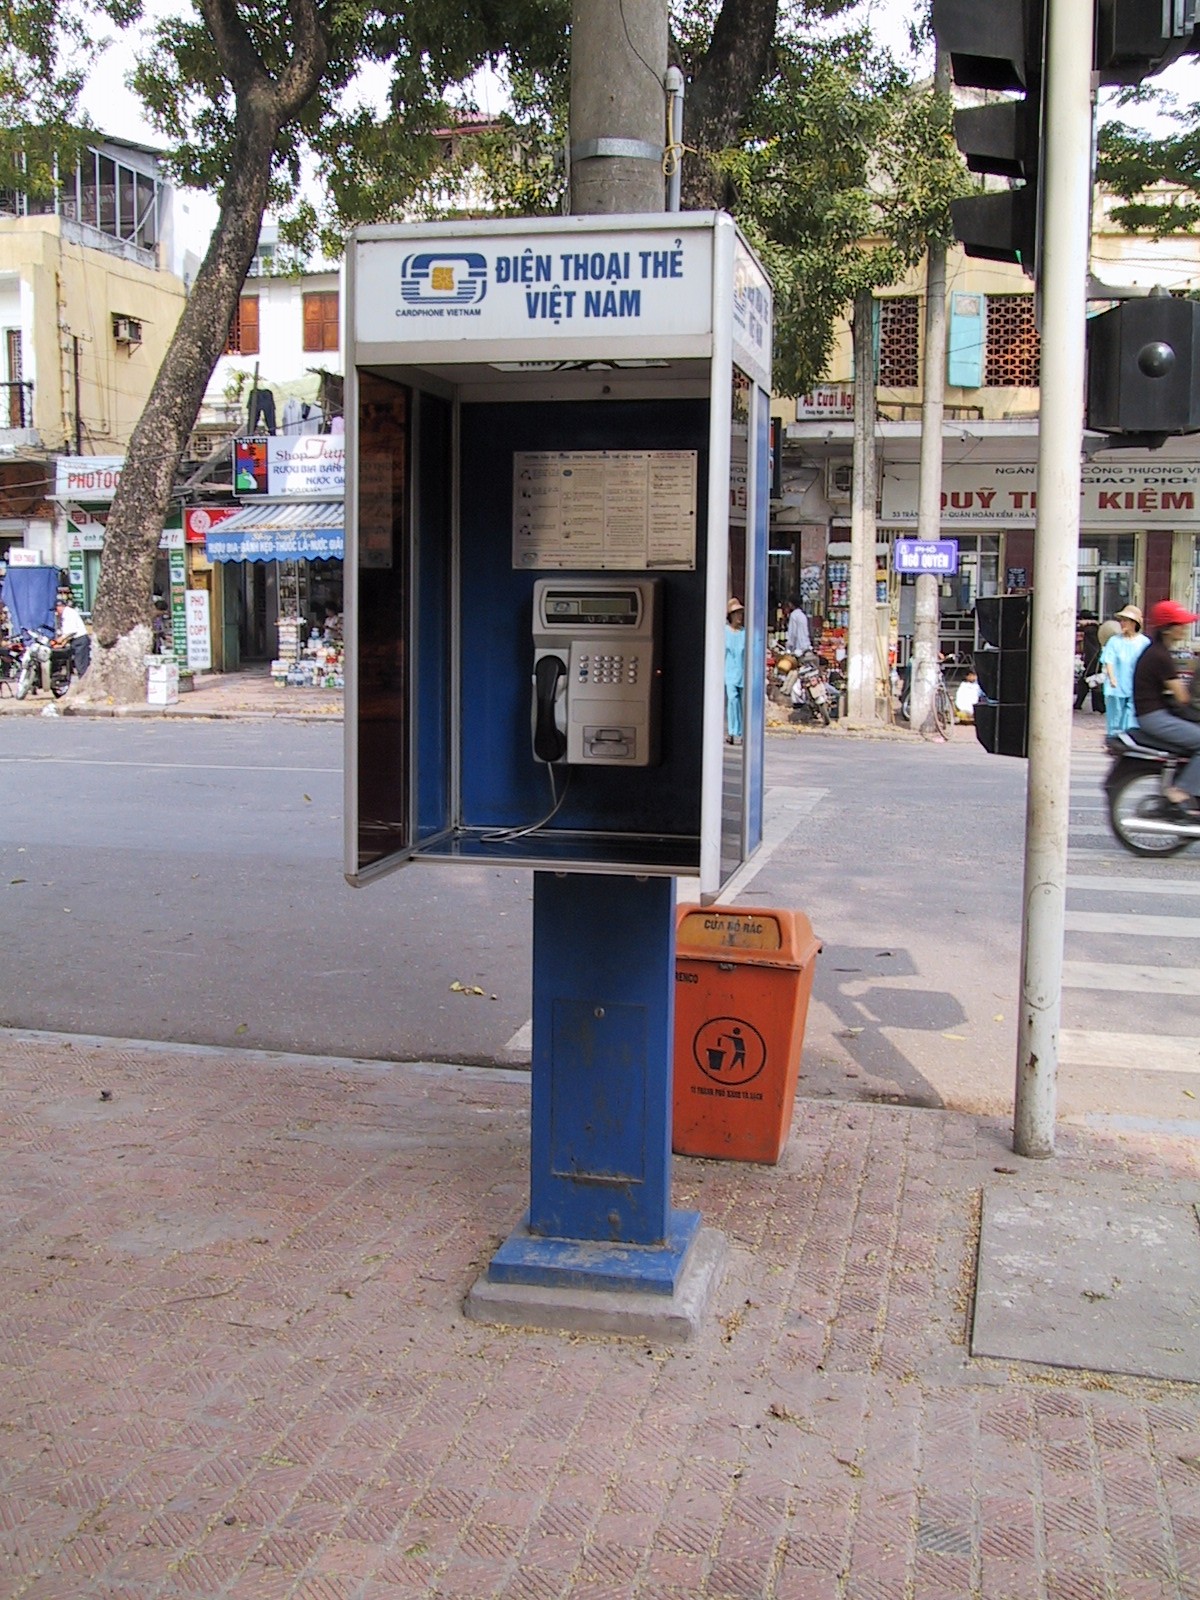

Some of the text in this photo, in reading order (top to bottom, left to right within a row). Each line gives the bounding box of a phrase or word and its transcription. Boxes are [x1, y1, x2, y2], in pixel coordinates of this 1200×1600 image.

[495, 238, 683, 289] ĐIỆN THOẠI THẺ
[396, 308, 481, 317] CARDPHONE VIETNAM
[525, 284, 641, 325] VIỆT NAM
[1080, 466, 1123, 474] CÔNG
[1143, 477, 1197, 485] DỊCH
[1098, 487, 1194, 513] KIỆM
